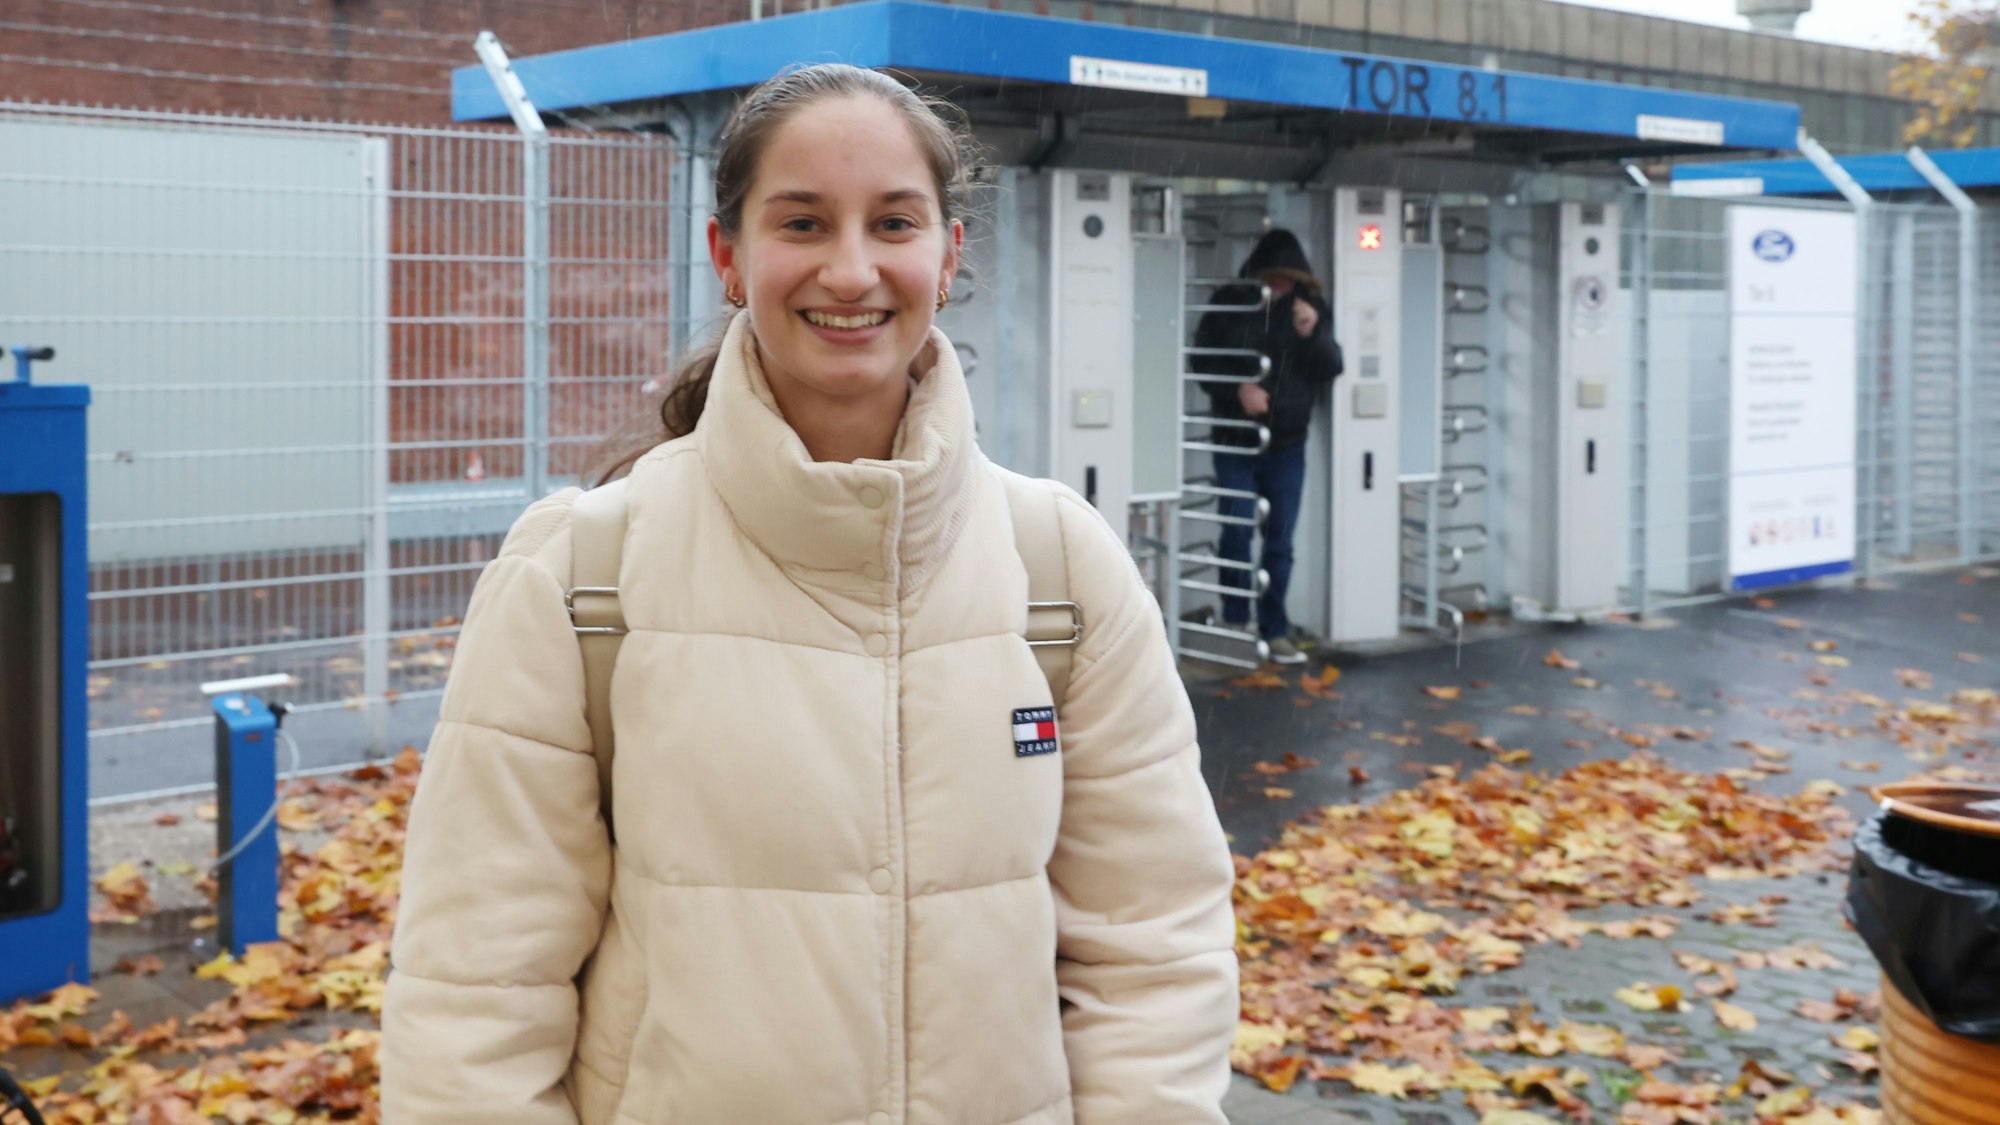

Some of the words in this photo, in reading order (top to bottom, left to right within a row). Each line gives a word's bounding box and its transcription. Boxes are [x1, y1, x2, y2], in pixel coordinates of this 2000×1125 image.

[1341, 56, 1431, 115] TOR
[1457, 71, 1507, 120] 8.1
[1015, 710, 1053, 722] TOMMY
[1016, 741, 1056, 753] JEANS
